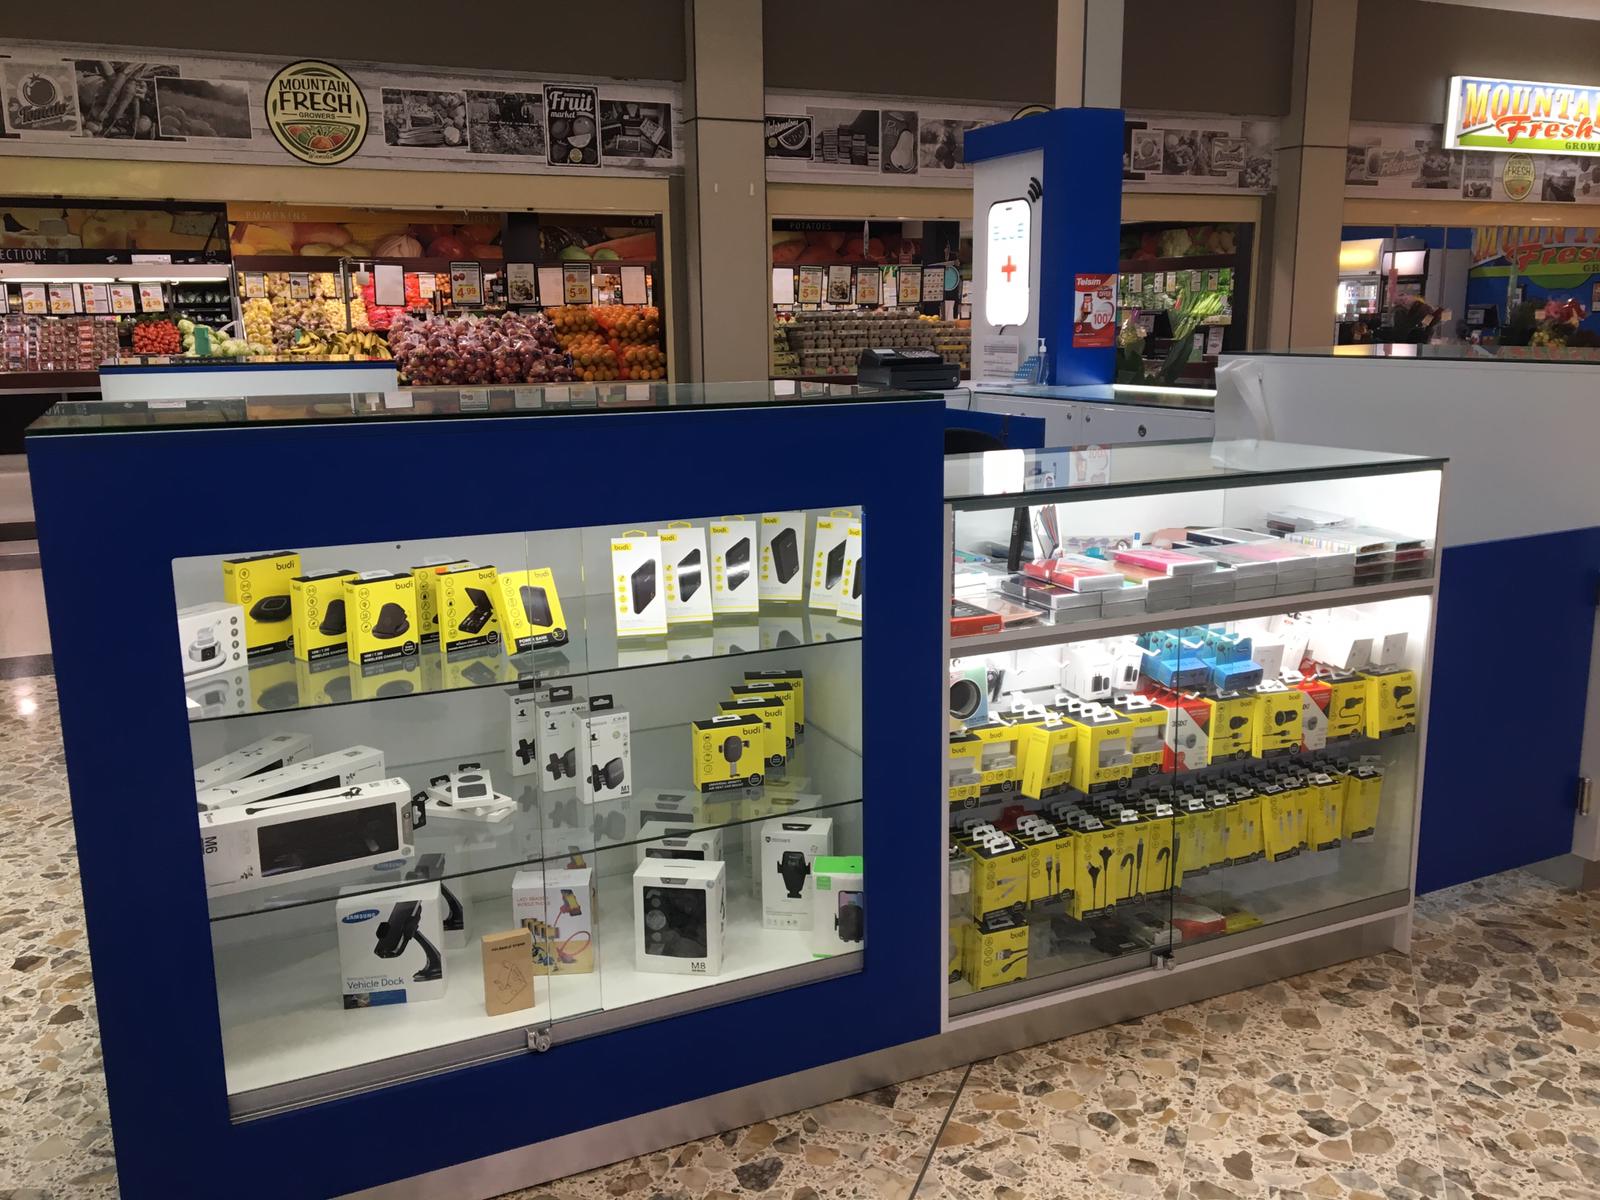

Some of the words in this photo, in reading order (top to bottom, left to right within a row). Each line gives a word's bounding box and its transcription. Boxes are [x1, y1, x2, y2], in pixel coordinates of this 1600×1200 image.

[279, 78, 350, 94] MOUNTAIN
[279, 91, 352, 114] FRESH
[548, 91, 594, 112] Fruit
[298, 112, 336, 120] GROWERS
[550, 111, 576, 119] market
[1495, 115, 1593, 144] Fresh
[1507, 165, 1532, 178] FRESH
[789, 222, 832, 230] POTATOES
[1077, 277, 1101, 286] Telsim
[276, 560, 295, 571] budi
[478, 571, 495, 580] budi
[395, 580, 414, 591] budi
[764, 709, 782, 718] budi
[743, 727, 761, 736] budi
[1106, 728, 1120, 736] budi
[951, 746, 967, 754] budi
[204, 835, 218, 854] M6
[1055, 842, 1071, 850] budi
[1011, 853, 1027, 864] budi
[346, 912, 376, 921] SAMSUNG
[1010, 930, 1026, 939] budi
[691, 962, 706, 970] M8
[347, 980, 379, 991] Vehicle
[381, 976, 404, 987] Dock
